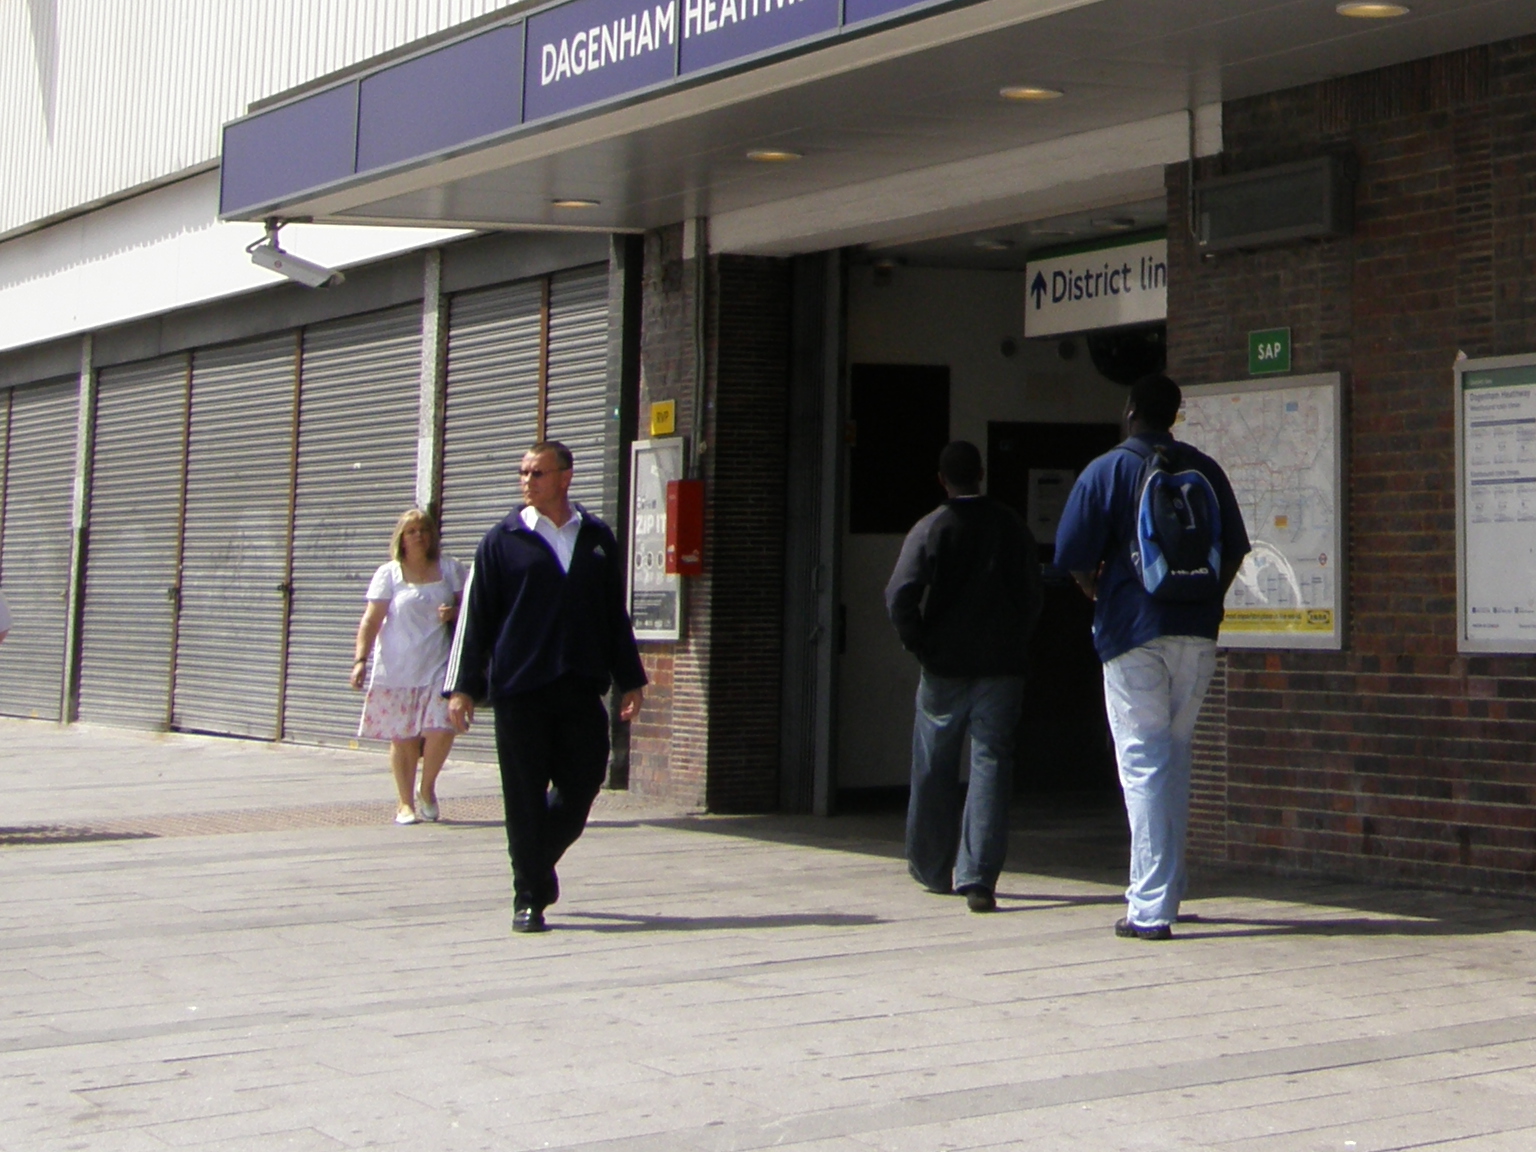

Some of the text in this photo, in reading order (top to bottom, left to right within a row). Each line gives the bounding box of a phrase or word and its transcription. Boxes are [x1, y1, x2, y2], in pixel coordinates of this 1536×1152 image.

[541, 0, 675, 86] DAGENHAM
[1052, 262, 1132, 304] District
[1257, 342, 1281, 360] SAP
